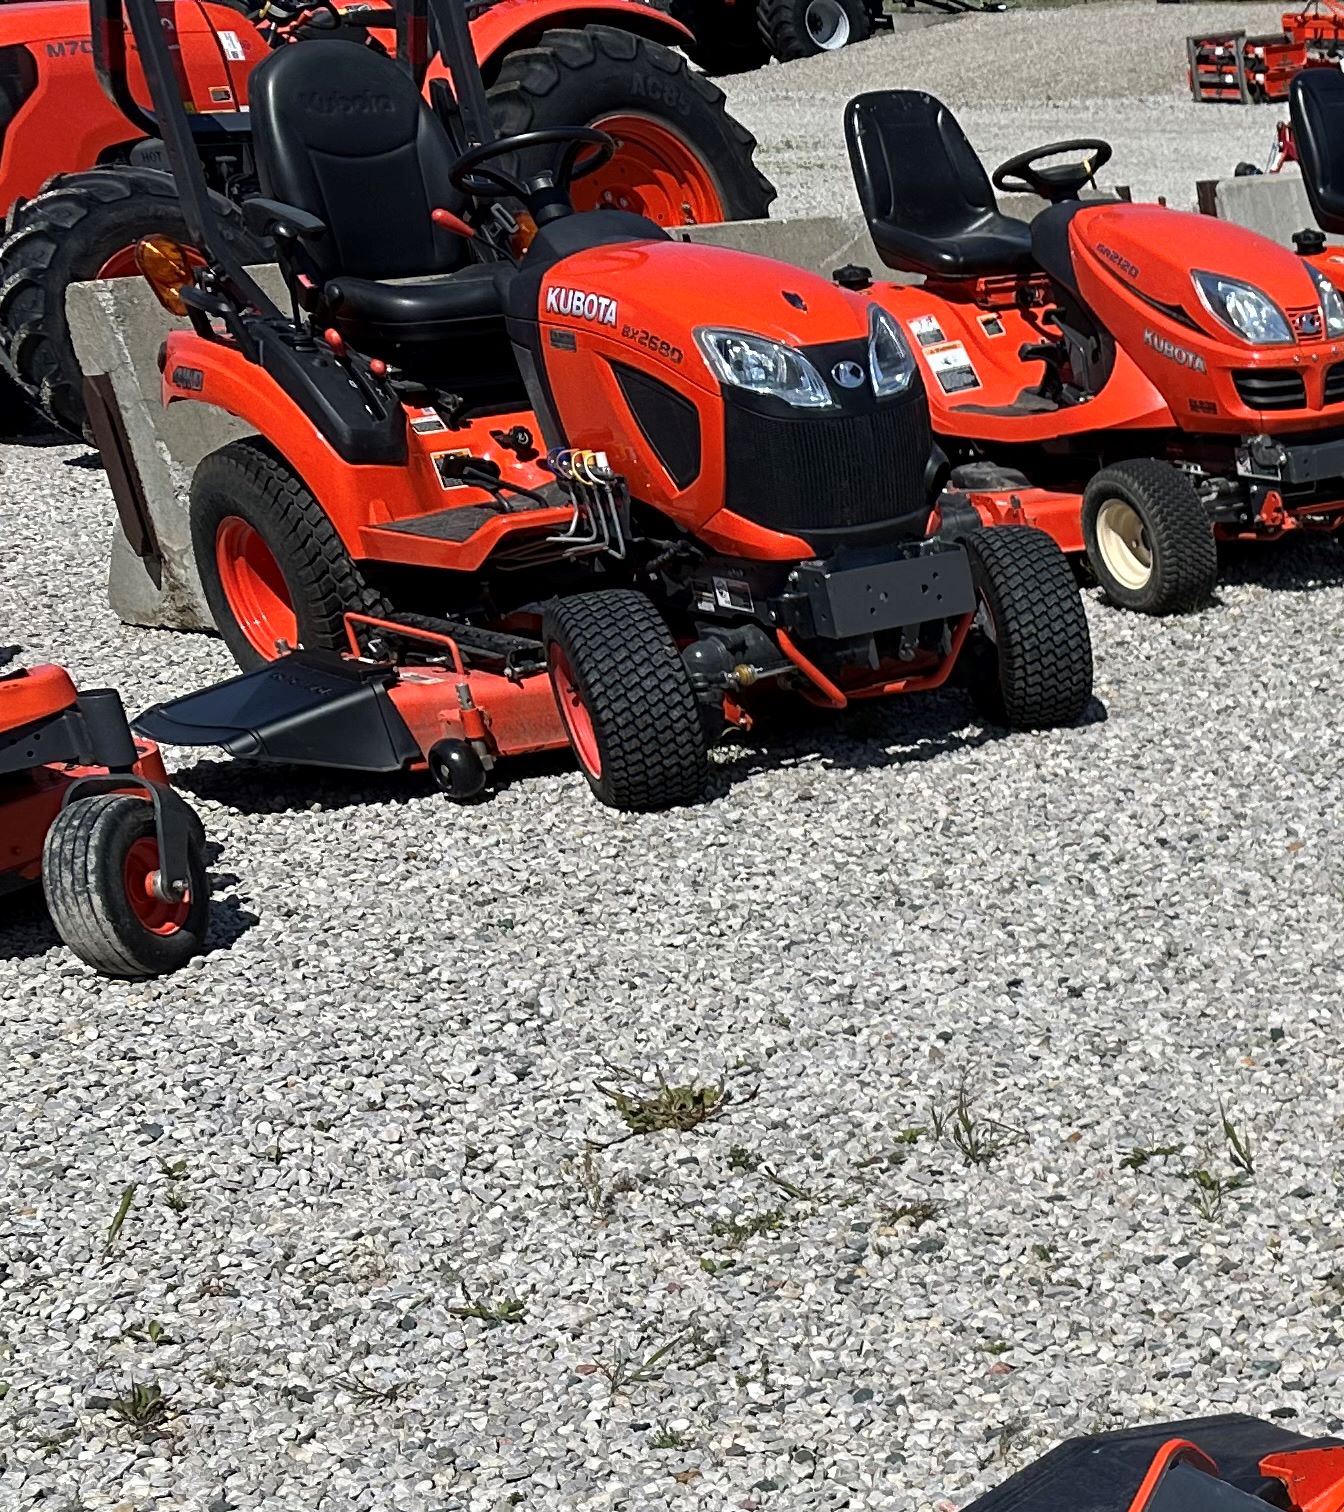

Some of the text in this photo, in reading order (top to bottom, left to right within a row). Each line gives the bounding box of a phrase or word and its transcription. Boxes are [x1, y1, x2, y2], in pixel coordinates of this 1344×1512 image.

[546, 286, 619, 328] KUBOTA
[620, 324, 685, 364] BX2680
[1143, 327, 1208, 375] KUBOTA
